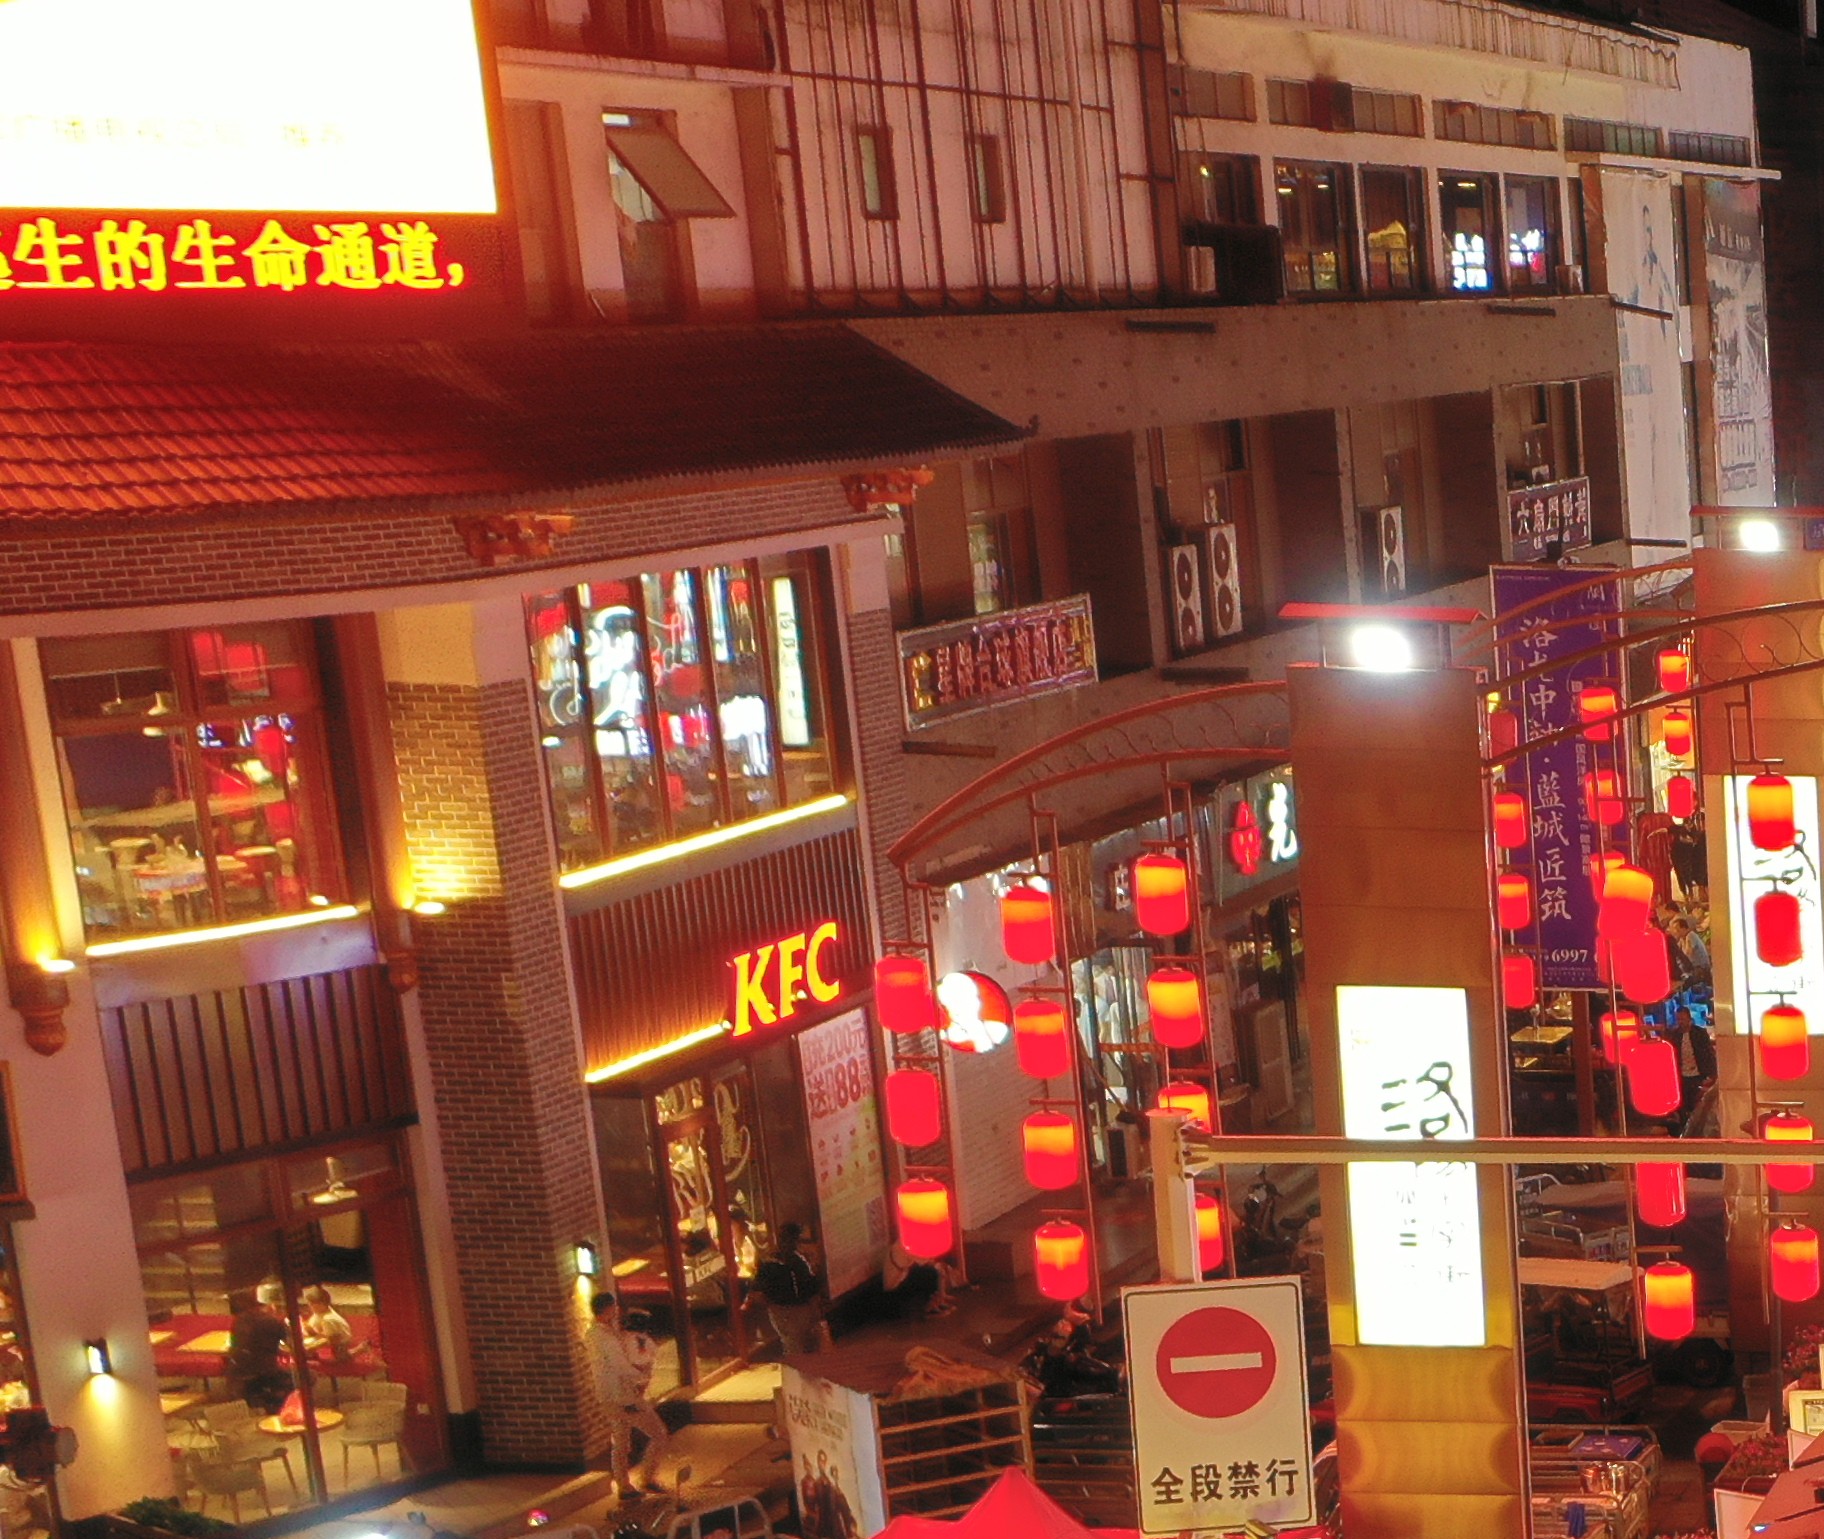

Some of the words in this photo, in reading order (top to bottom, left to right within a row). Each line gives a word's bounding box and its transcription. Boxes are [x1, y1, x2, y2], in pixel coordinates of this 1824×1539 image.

[731, 921, 841, 1038] KFC
[1150, 1458, 1300, 1507] 全段禁行
